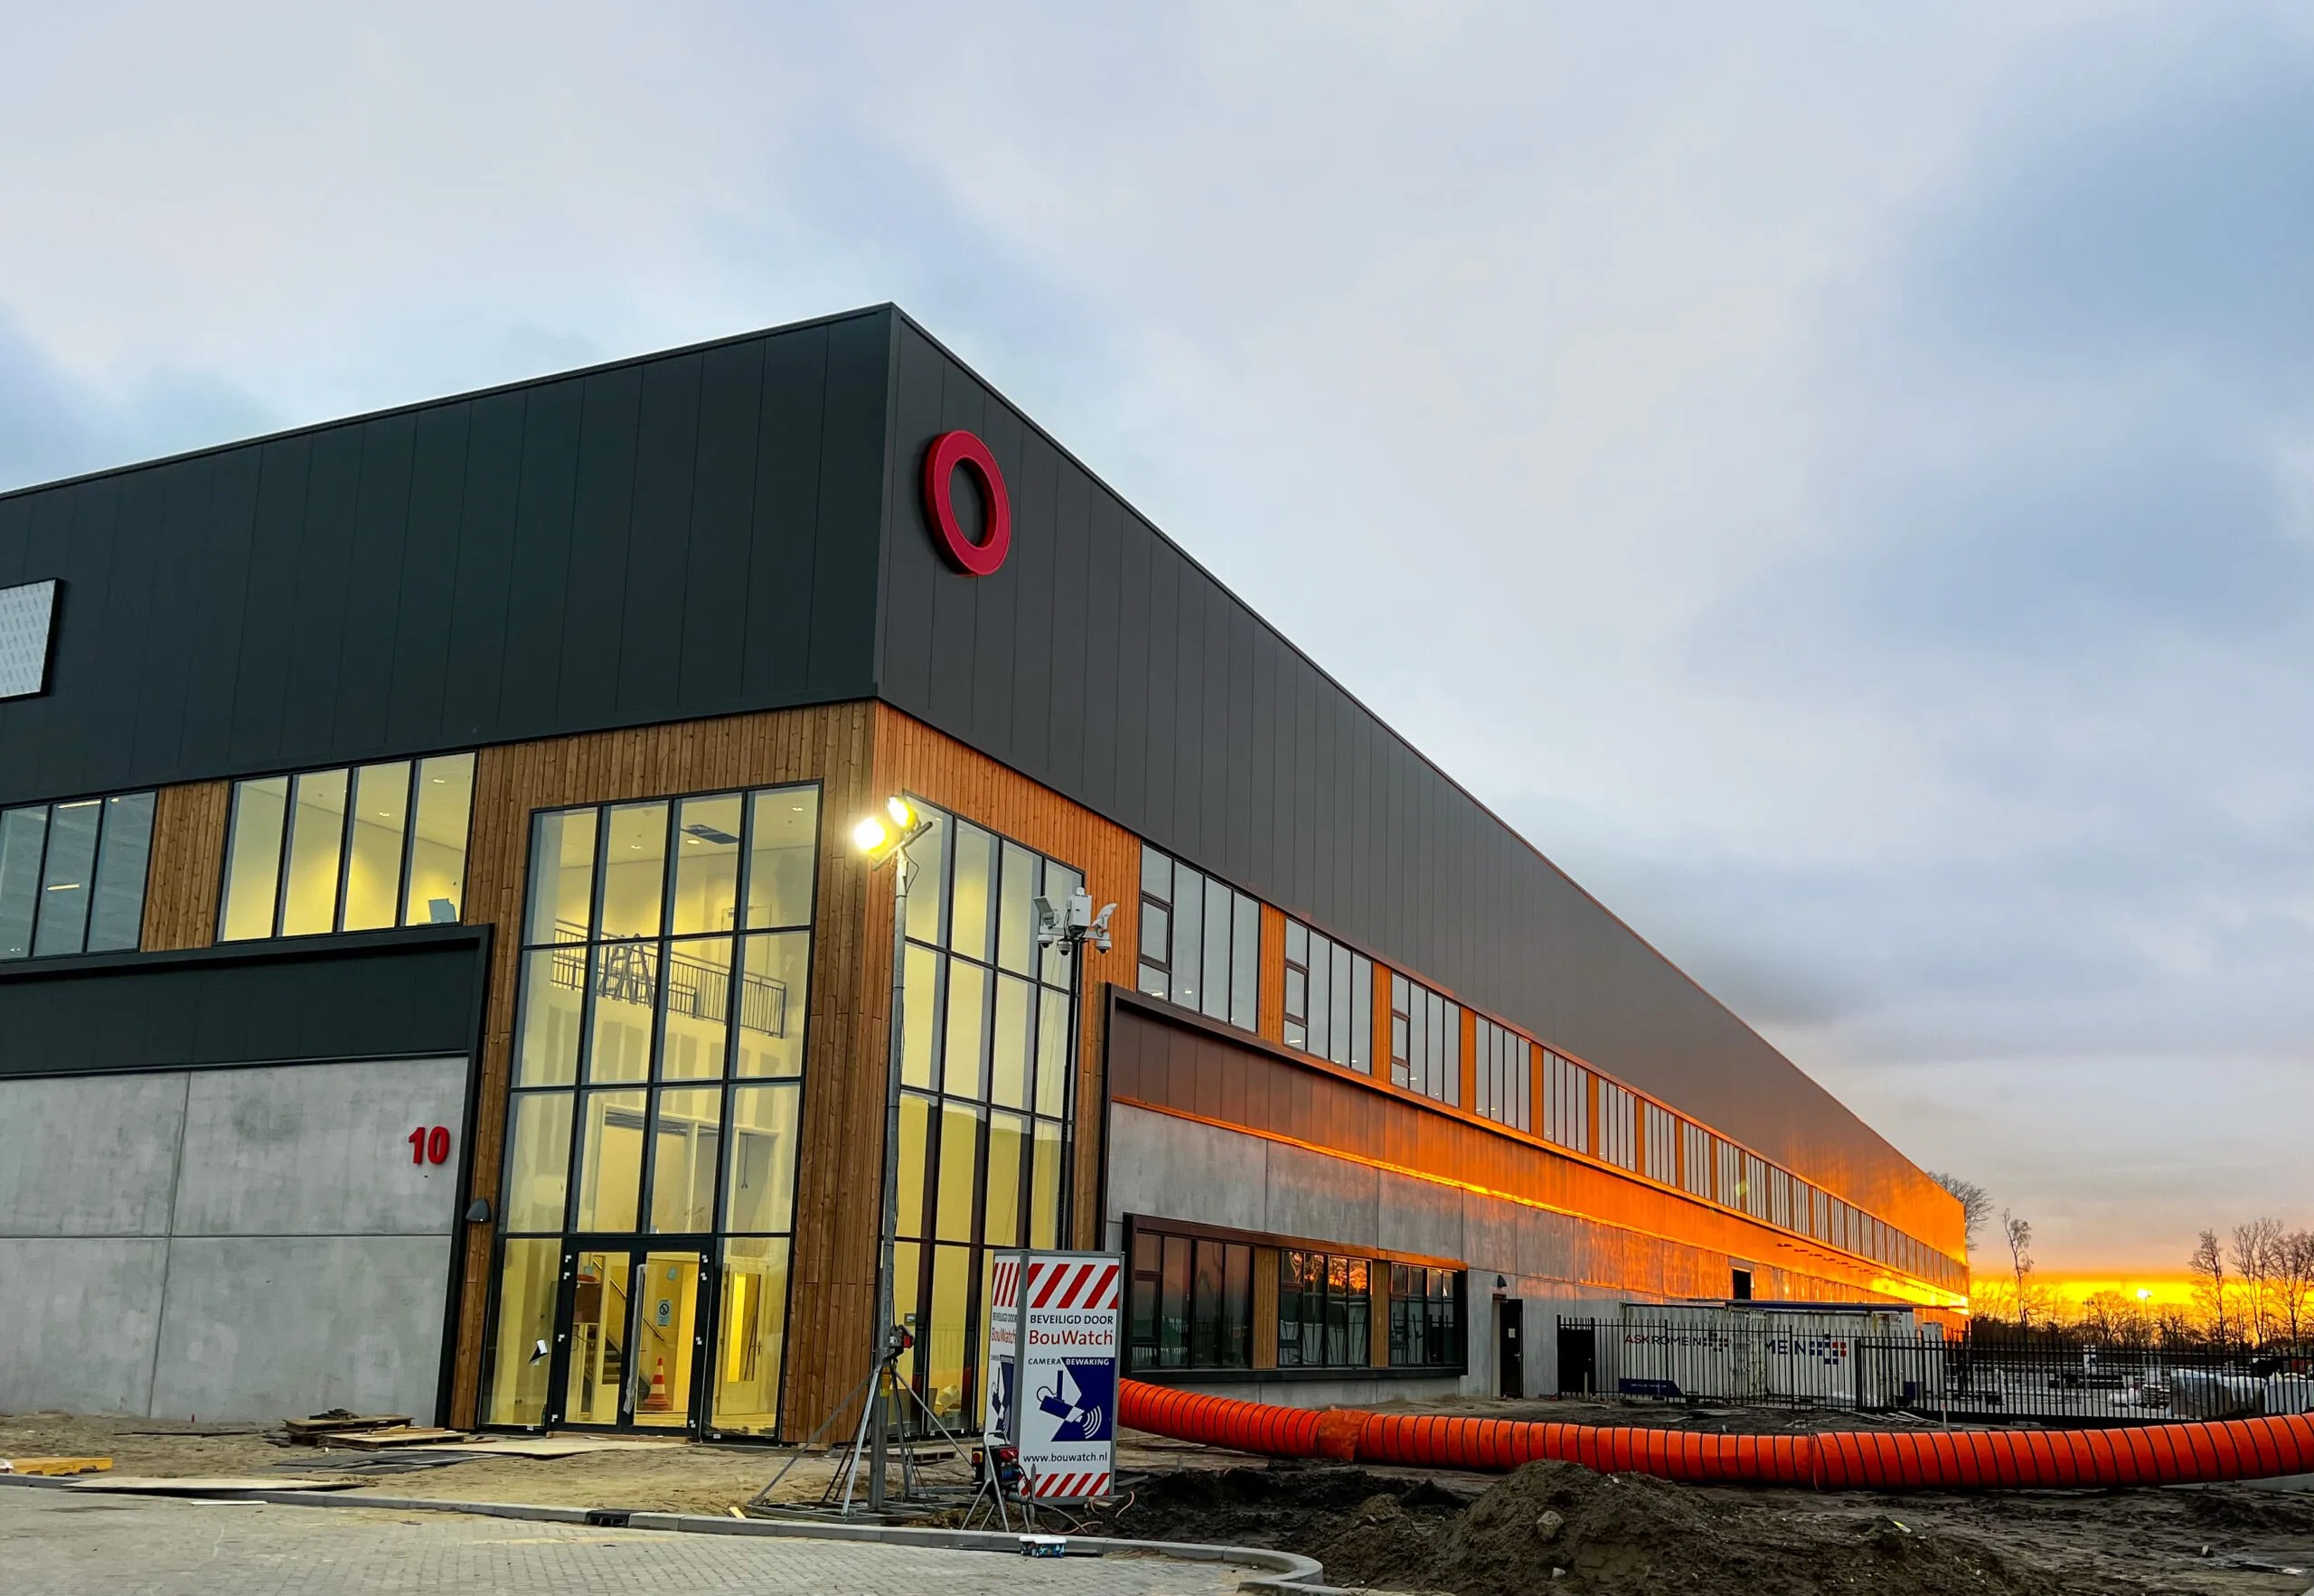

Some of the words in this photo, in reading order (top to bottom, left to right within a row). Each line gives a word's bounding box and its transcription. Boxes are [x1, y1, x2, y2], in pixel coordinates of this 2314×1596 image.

[408, 1126, 450, 1165] 10
[1030, 1314, 1082, 1325] BEVEILIGD
[1084, 1315, 1114, 1325] DOOR
[1029, 1329, 1113, 1346] BouWatch
[1764, 1339, 1807, 1356] MEN
[1028, 1357, 1061, 1366] CAMERA
[1023, 1451, 1107, 1462] www.bouwatch.nl
